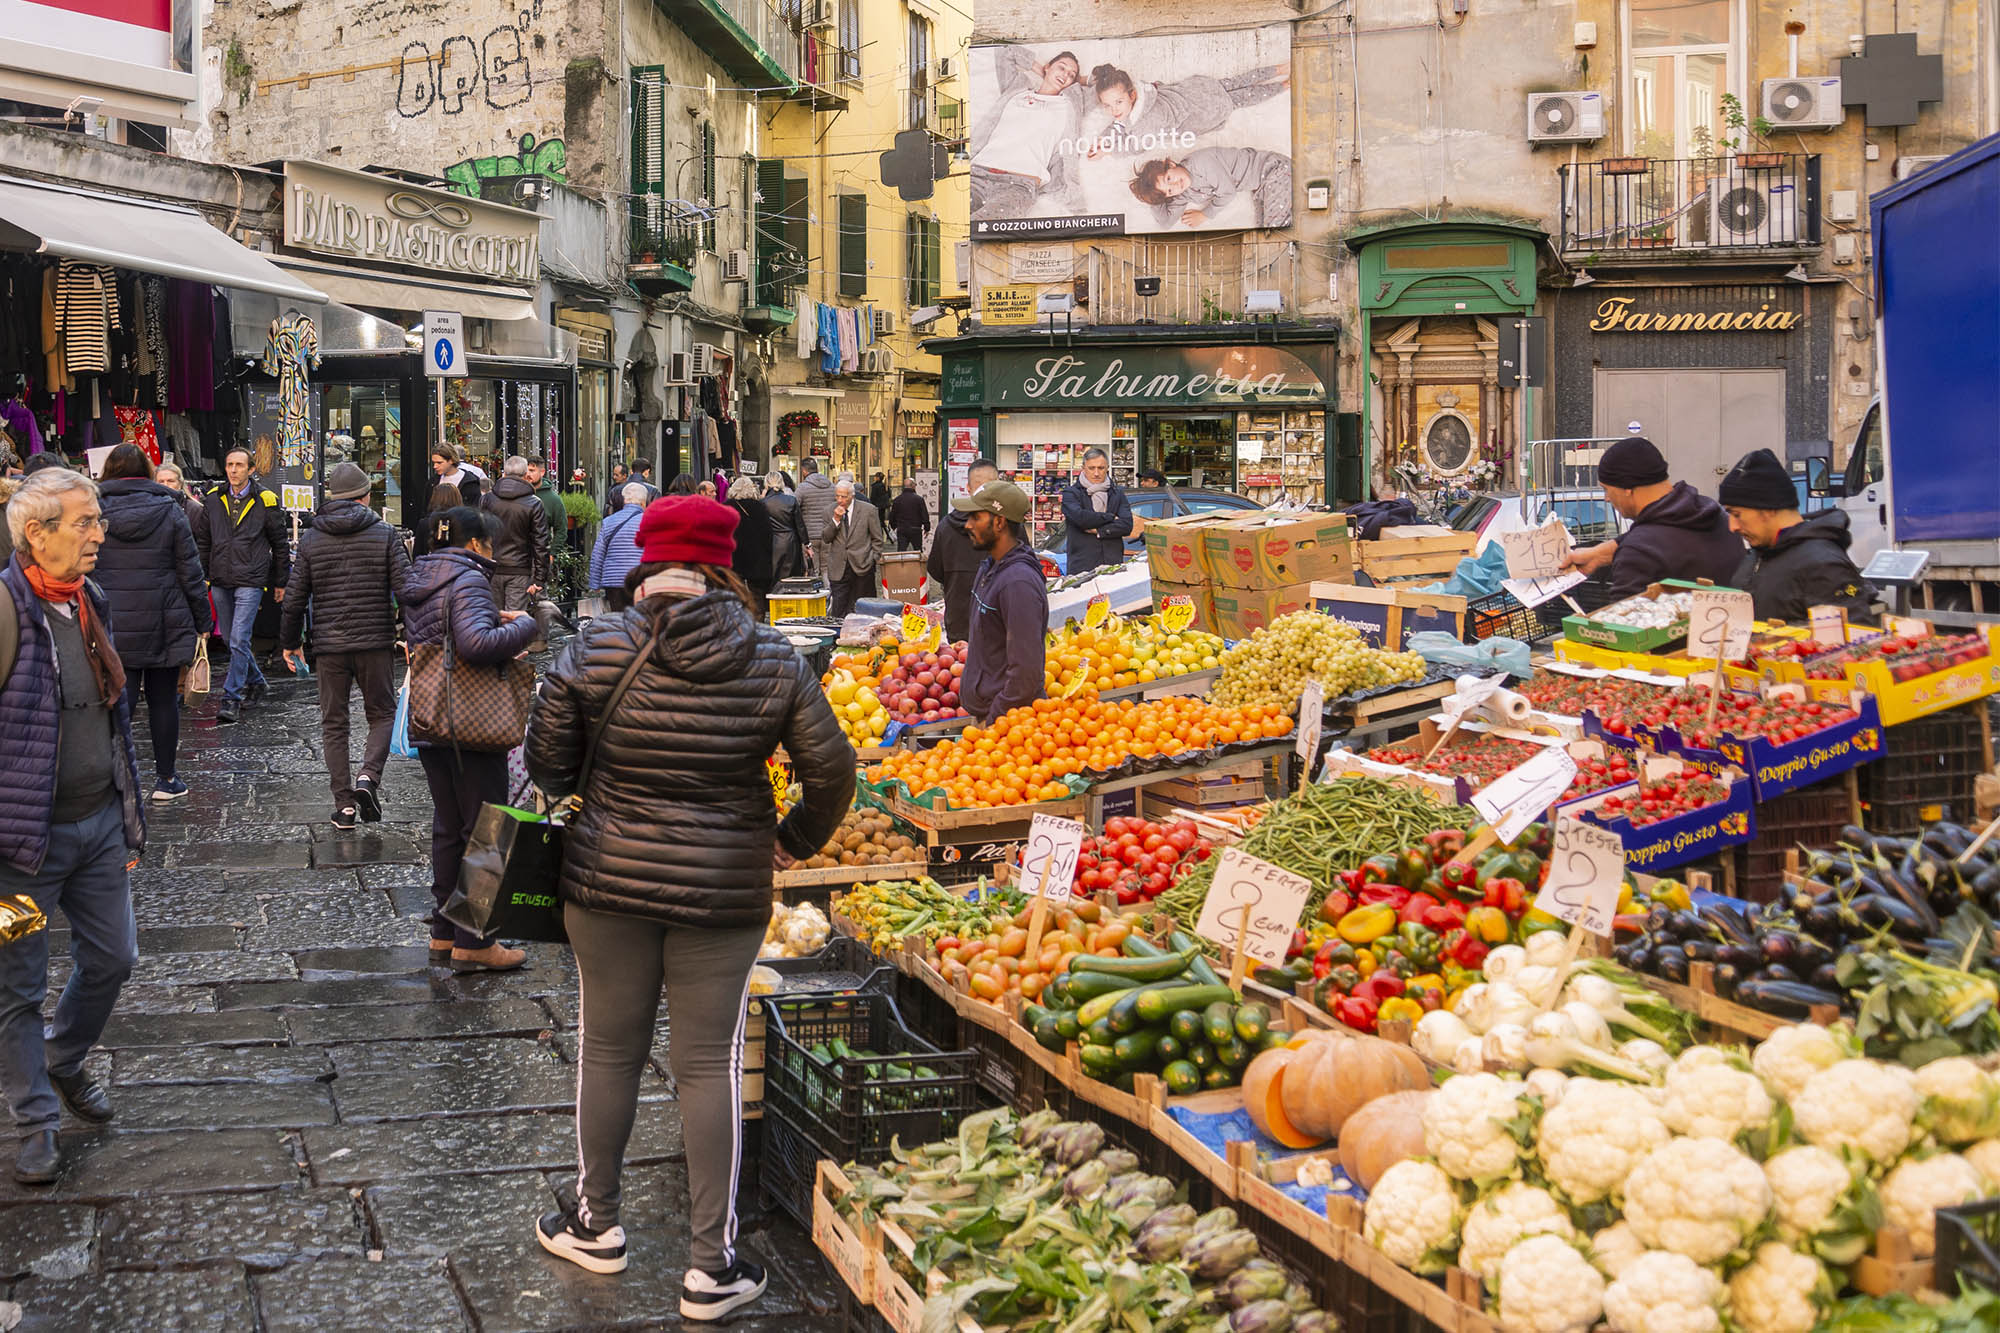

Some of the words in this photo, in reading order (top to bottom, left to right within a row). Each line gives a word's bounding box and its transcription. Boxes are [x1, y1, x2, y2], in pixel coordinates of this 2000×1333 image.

[294, 184, 361, 250] BAR
[366, 213, 540, 281] PASTICCERIA
[992, 220, 1052, 233] COZZOLINO
[1054, 217, 1119, 230] BIANCHERIA
[1028, 250, 1053, 260] PIAZZA
[431, 326, 456, 335] pedonale
[1589, 297, 1801, 331] Farmacia
[1024, 355, 1289, 398] Salumeria
[1855, 385, 1862, 393] 2
[840, 402, 868, 416] FRANCHI
[891, 587, 918, 595] UMIDO
[1699, 607, 1736, 644] 2
[1758, 757, 1807, 783] Doppio
[1808, 740, 1850, 768] Gusto
[1034, 815, 1082, 834] OFFERTA
[1572, 826, 1624, 857] TESTE
[1623, 838, 1671, 866] Doppio
[1673, 824, 1717, 853] Gusto
[1223, 851, 1310, 895] OFFERTA
[1553, 850, 1601, 914] 2
[1217, 880, 1265, 940] 2
